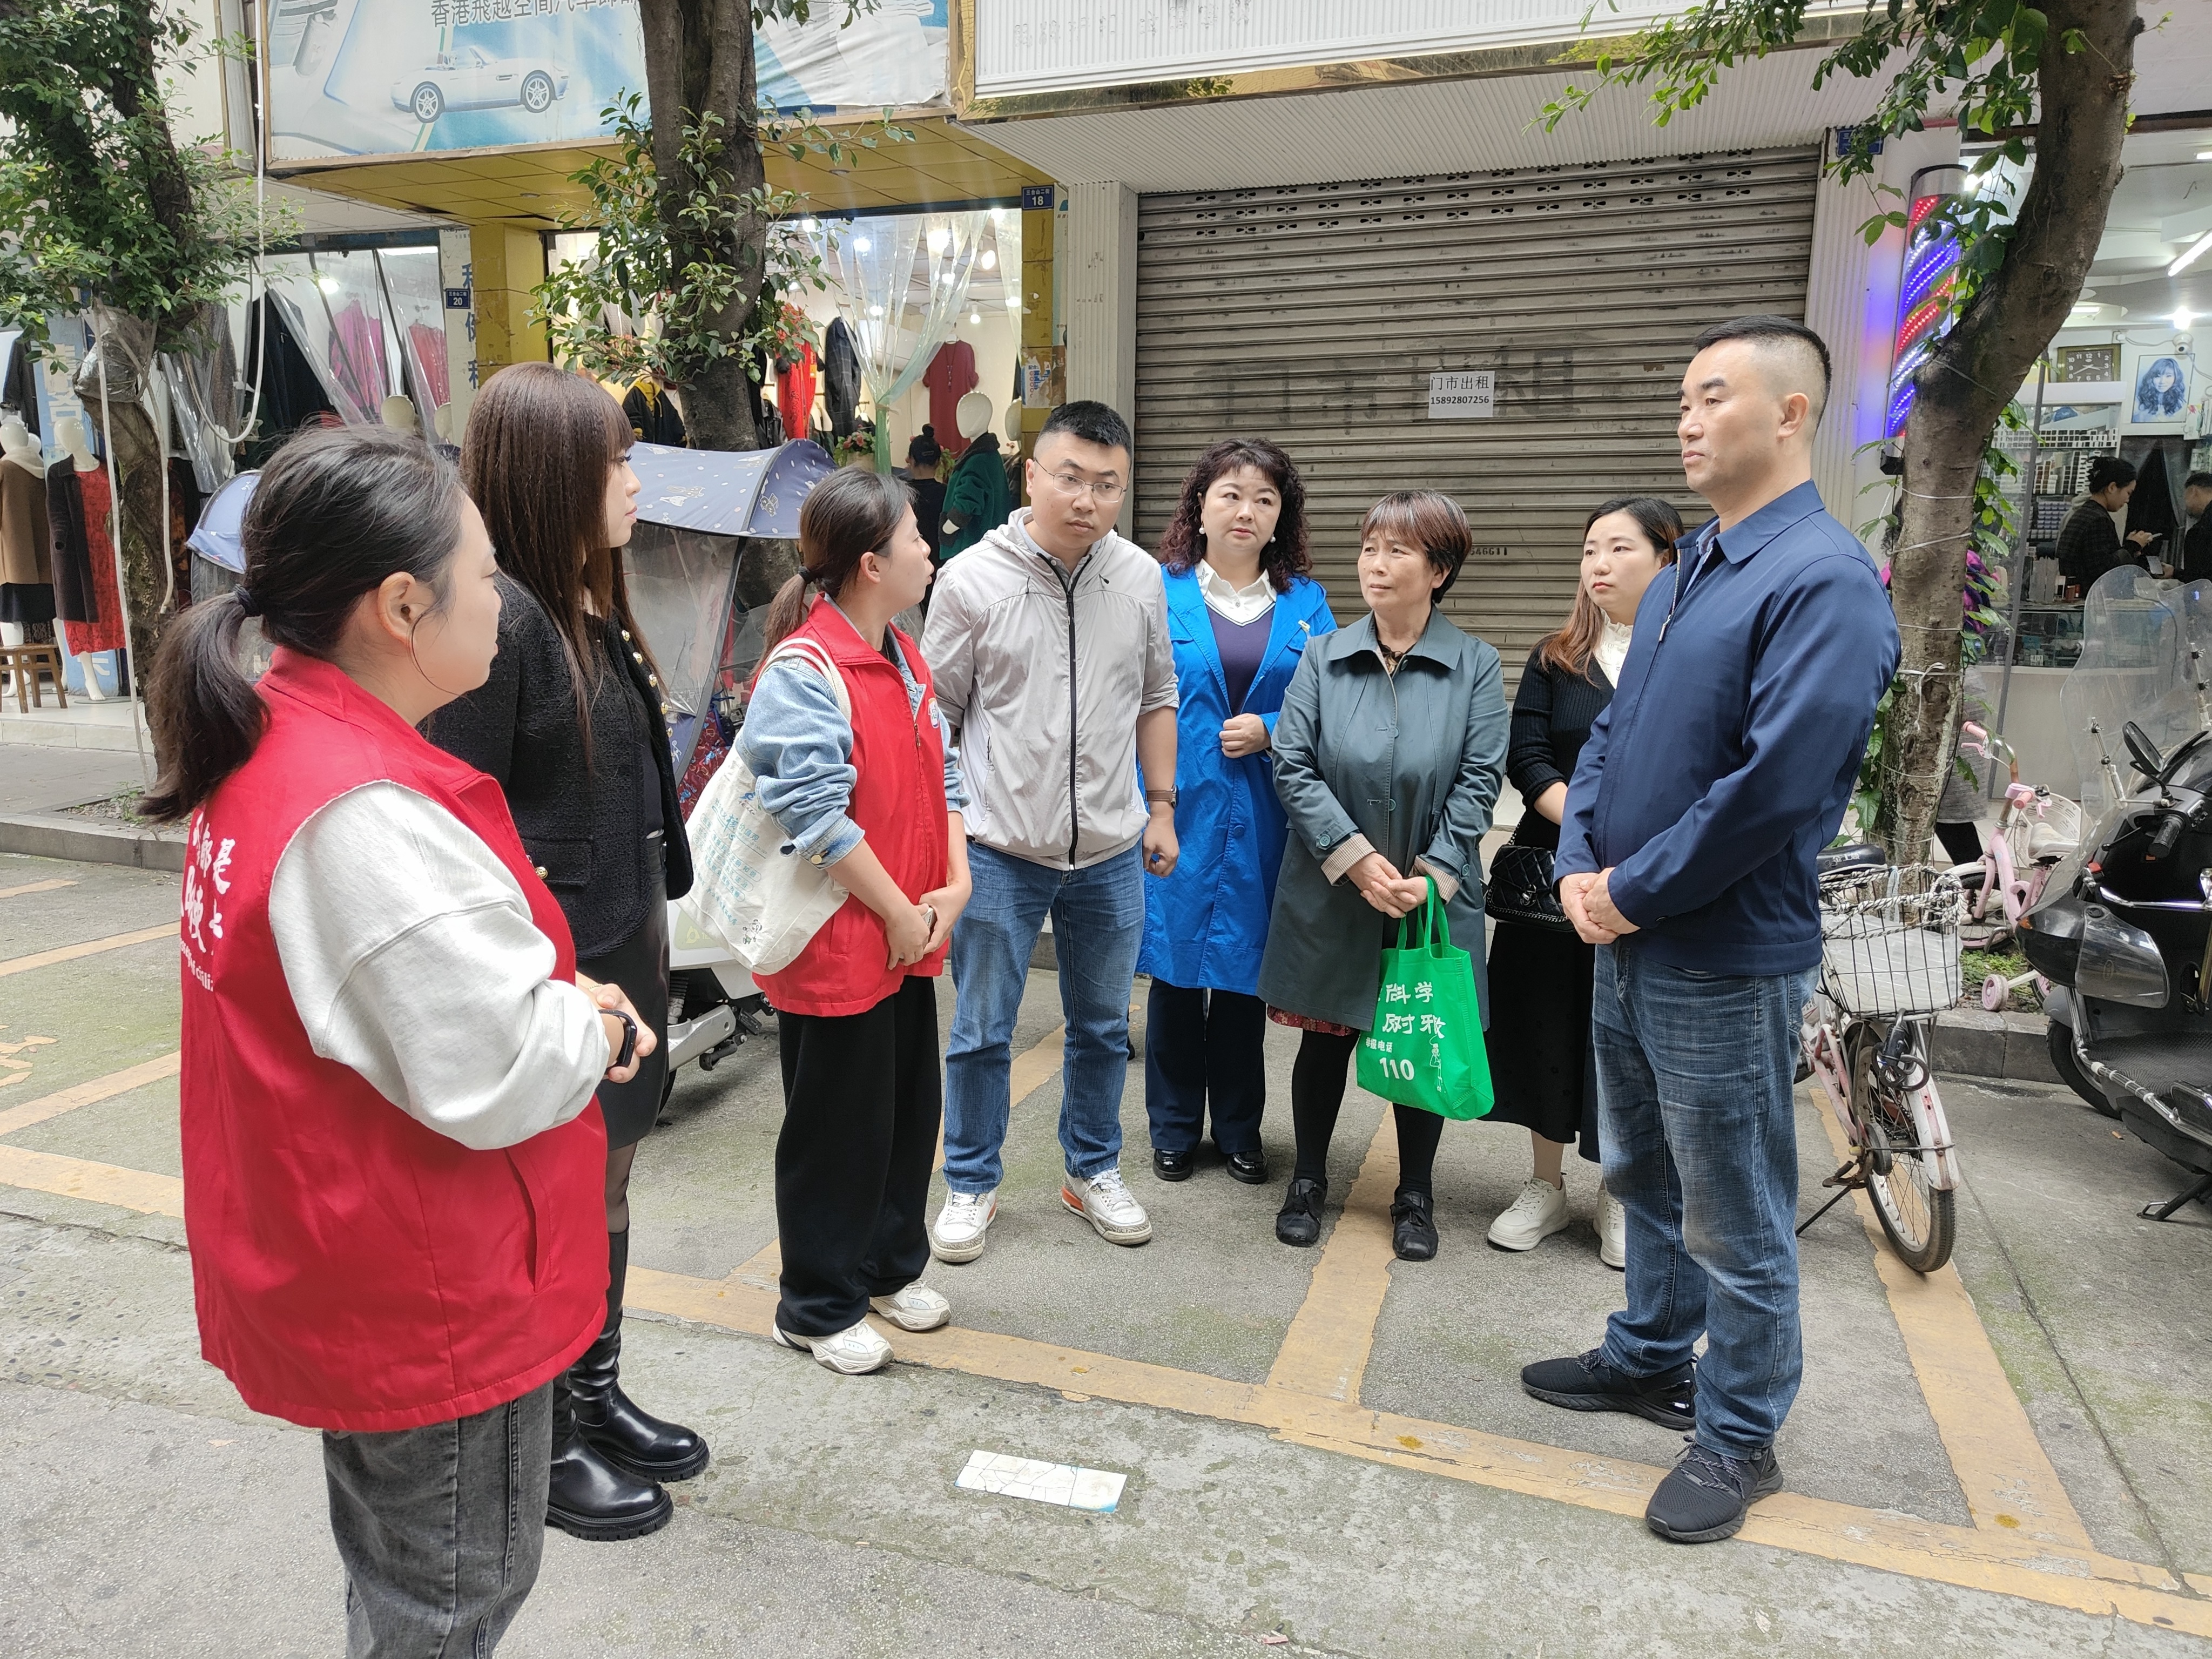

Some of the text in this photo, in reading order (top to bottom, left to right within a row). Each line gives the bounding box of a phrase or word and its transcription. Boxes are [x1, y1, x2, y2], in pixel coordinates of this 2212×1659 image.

[1032, 196, 1043, 206] 18
[453, 298, 463, 306] 20
[1431, 376, 1489, 390] 门市出租
[1431, 395, 1489, 404] 15892807256
[1379, 1056, 1415, 1081] 110
